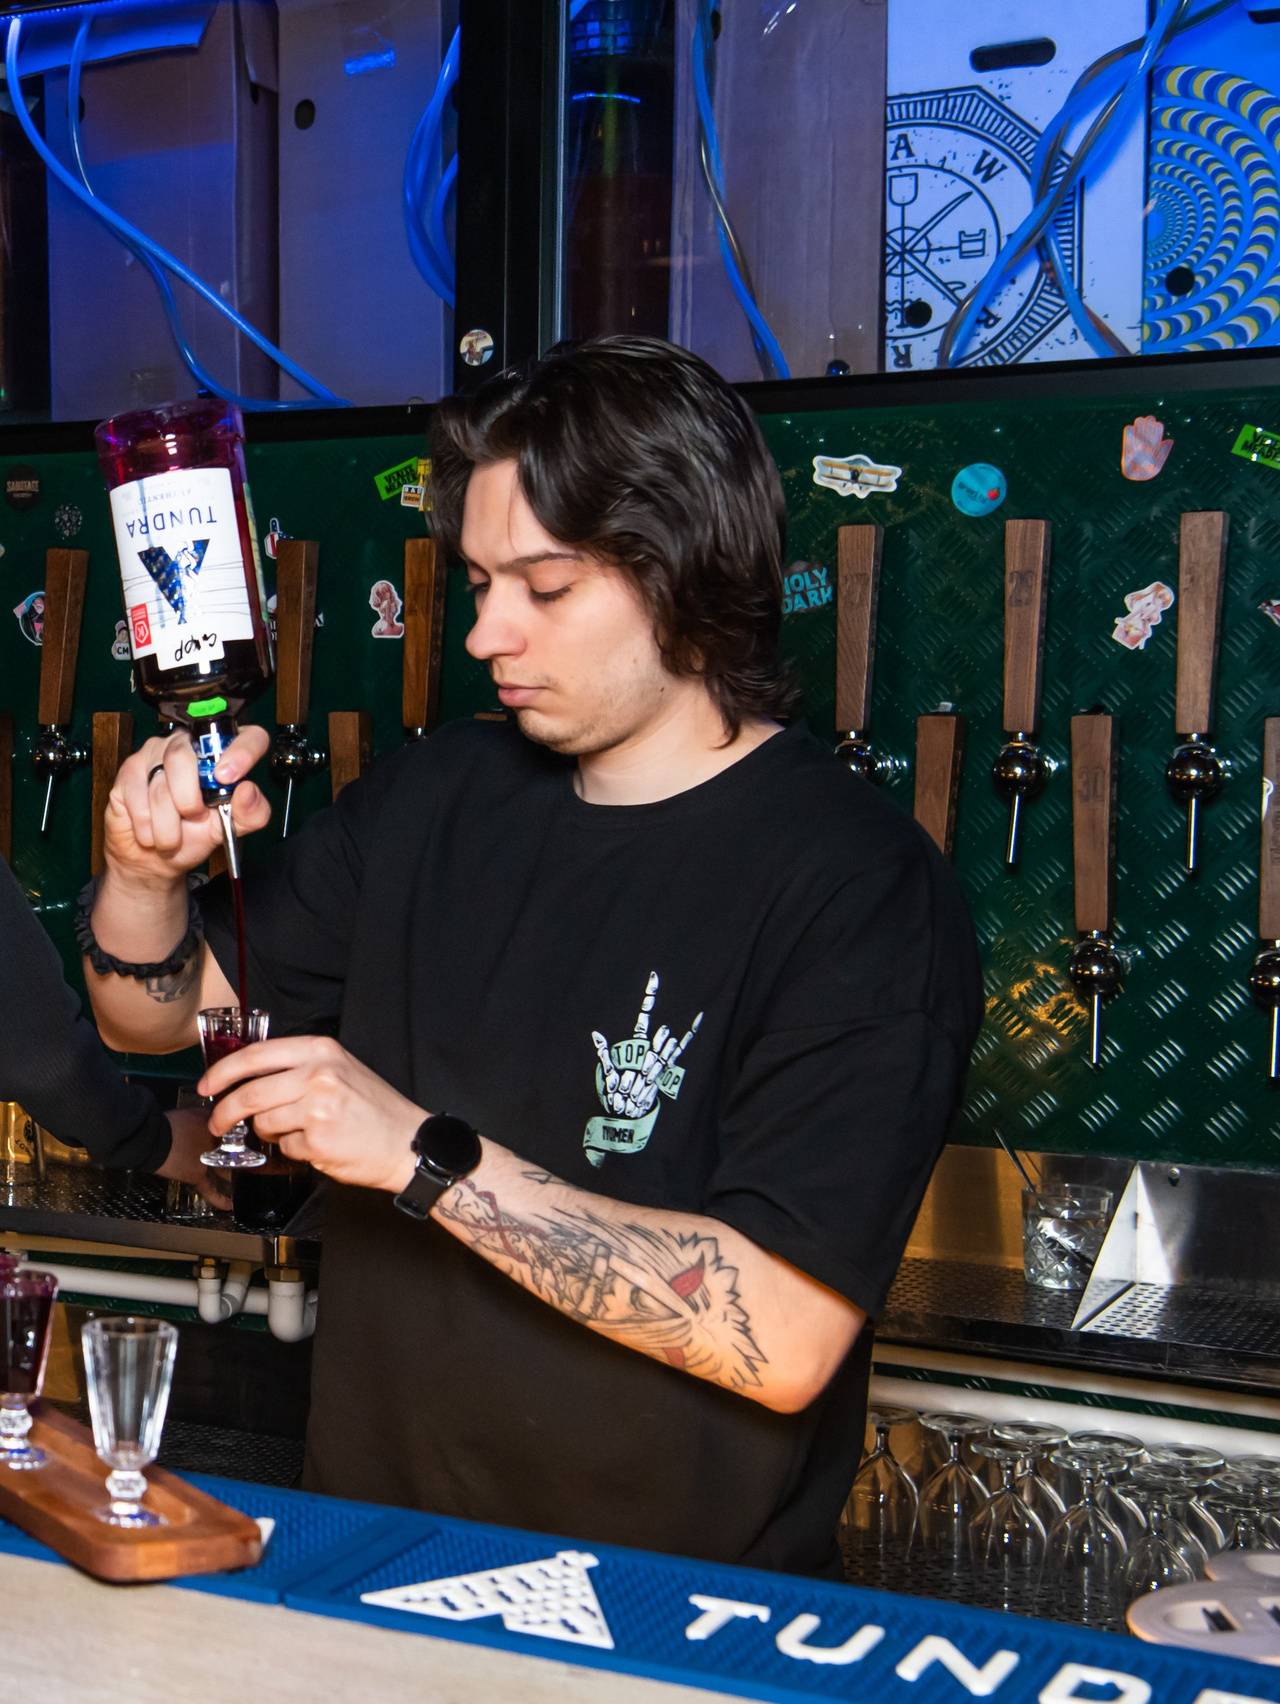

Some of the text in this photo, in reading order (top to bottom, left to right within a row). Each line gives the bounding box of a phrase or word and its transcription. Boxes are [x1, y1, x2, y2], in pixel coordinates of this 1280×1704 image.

[972, 148, 1008, 184] W
[6, 480, 40, 493] SABOTAGE
[126, 505, 218, 539] TUNDRA
[782, 586, 833, 614] DARK
[614, 1044, 645, 1066] TOP
